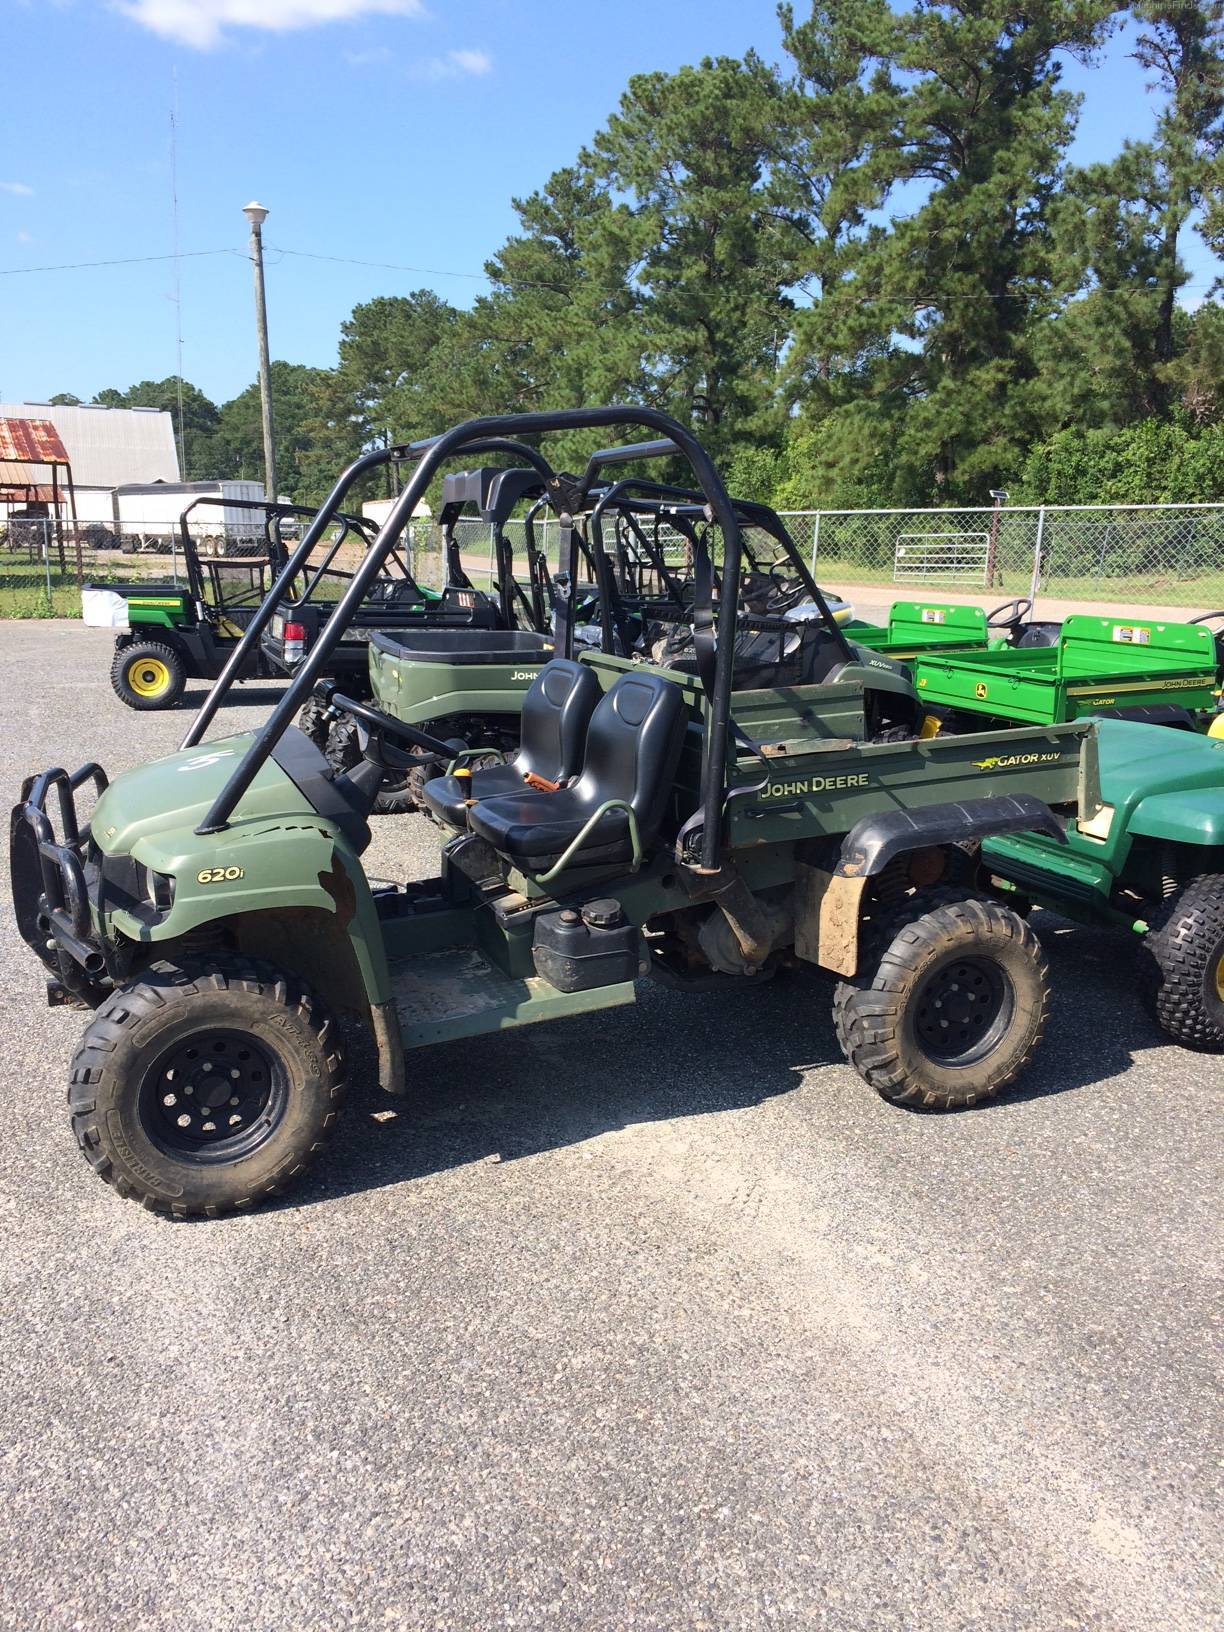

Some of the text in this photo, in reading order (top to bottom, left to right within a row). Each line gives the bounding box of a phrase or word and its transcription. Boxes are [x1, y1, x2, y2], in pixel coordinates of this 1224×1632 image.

[1160, 680, 1182, 689] JOHN
[1092, 698, 1116, 706] GATOR
[997, 752, 1061, 767] GATOR XUV
[761, 773, 869, 798] JOHN DEERE
[197, 866, 245, 884] 620i
